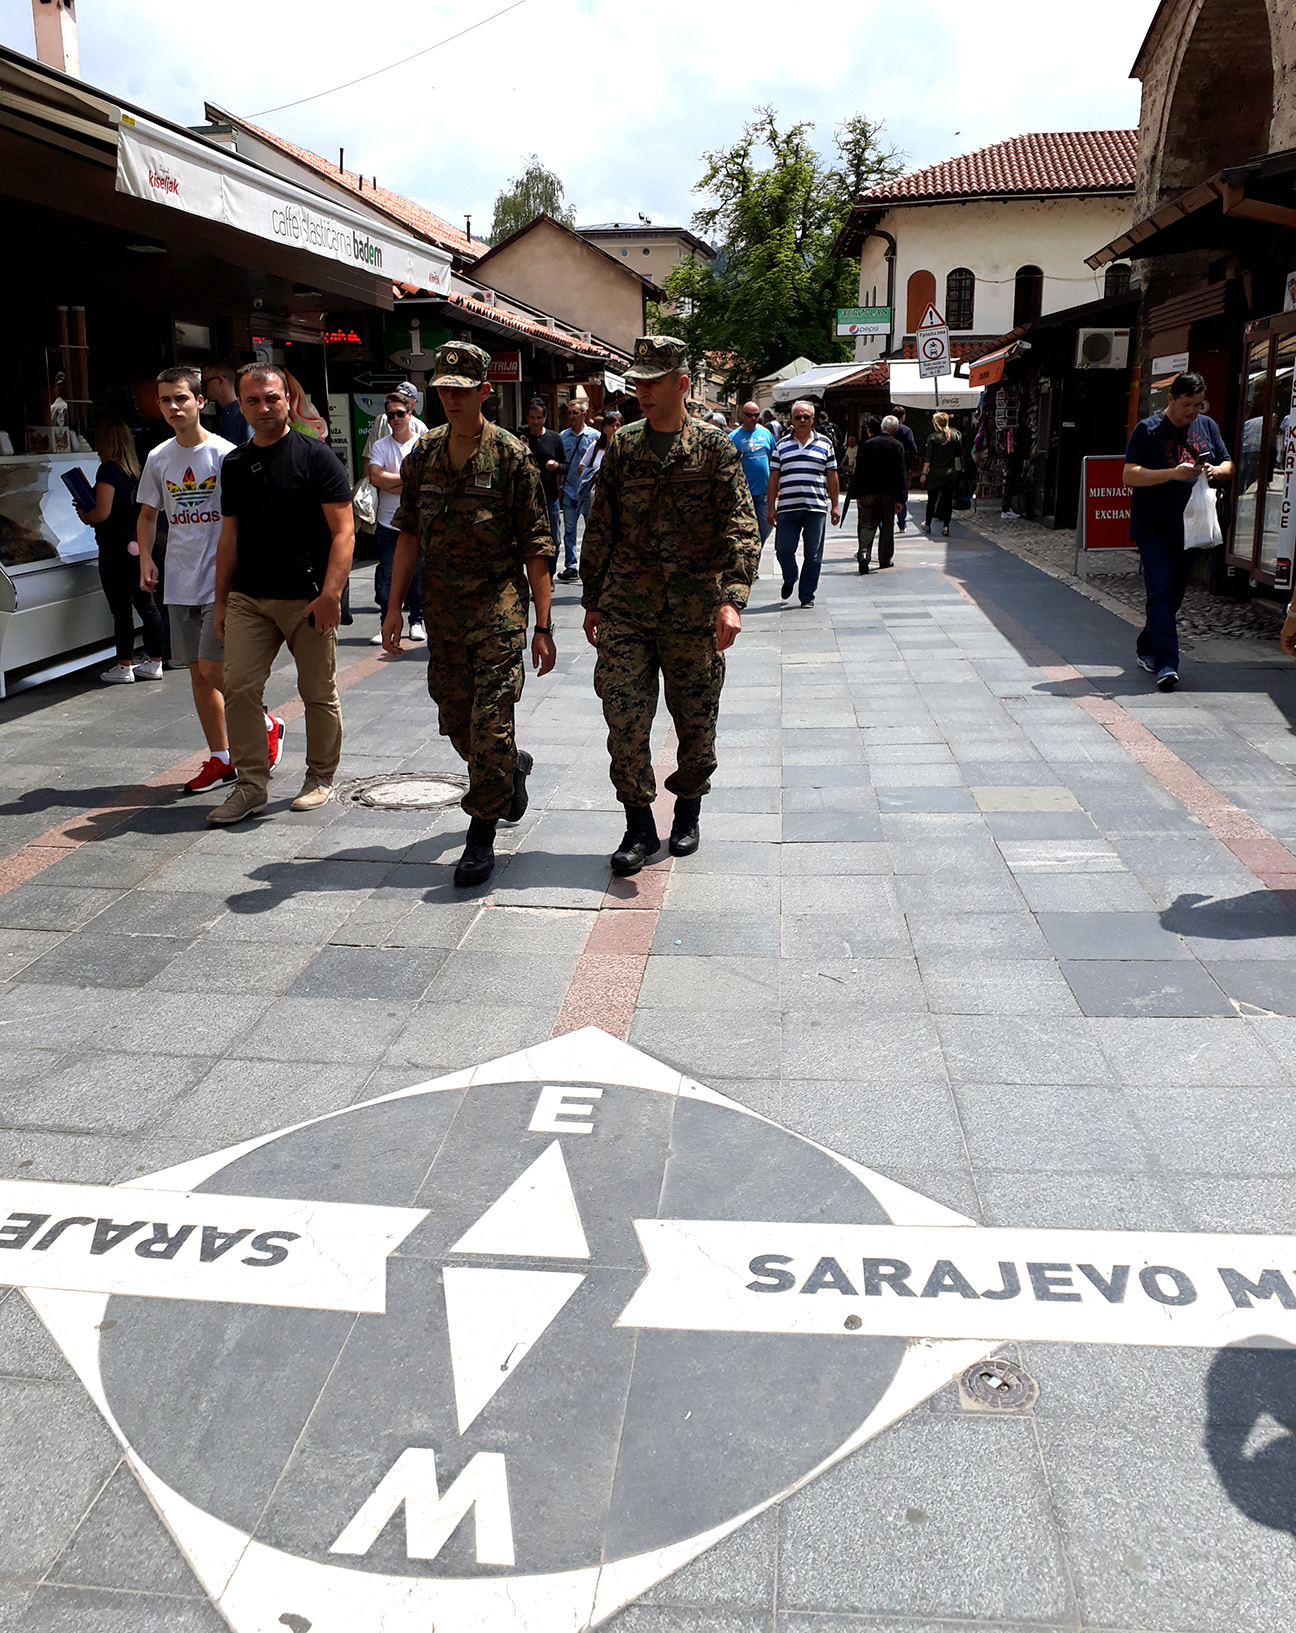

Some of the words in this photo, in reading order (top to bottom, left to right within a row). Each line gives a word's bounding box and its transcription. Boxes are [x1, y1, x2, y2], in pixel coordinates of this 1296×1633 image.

[149, 171, 178, 195] kiseljak
[271, 206, 300, 240] caffe
[353, 231, 382, 268] badem
[859, 325, 879, 333] pepsi
[170, 509, 220, 525] adidas
[528, 1086, 604, 1134] E
[747, 1254, 1199, 1307] SARAJEVO
[1217, 1267, 1296, 1310] M
